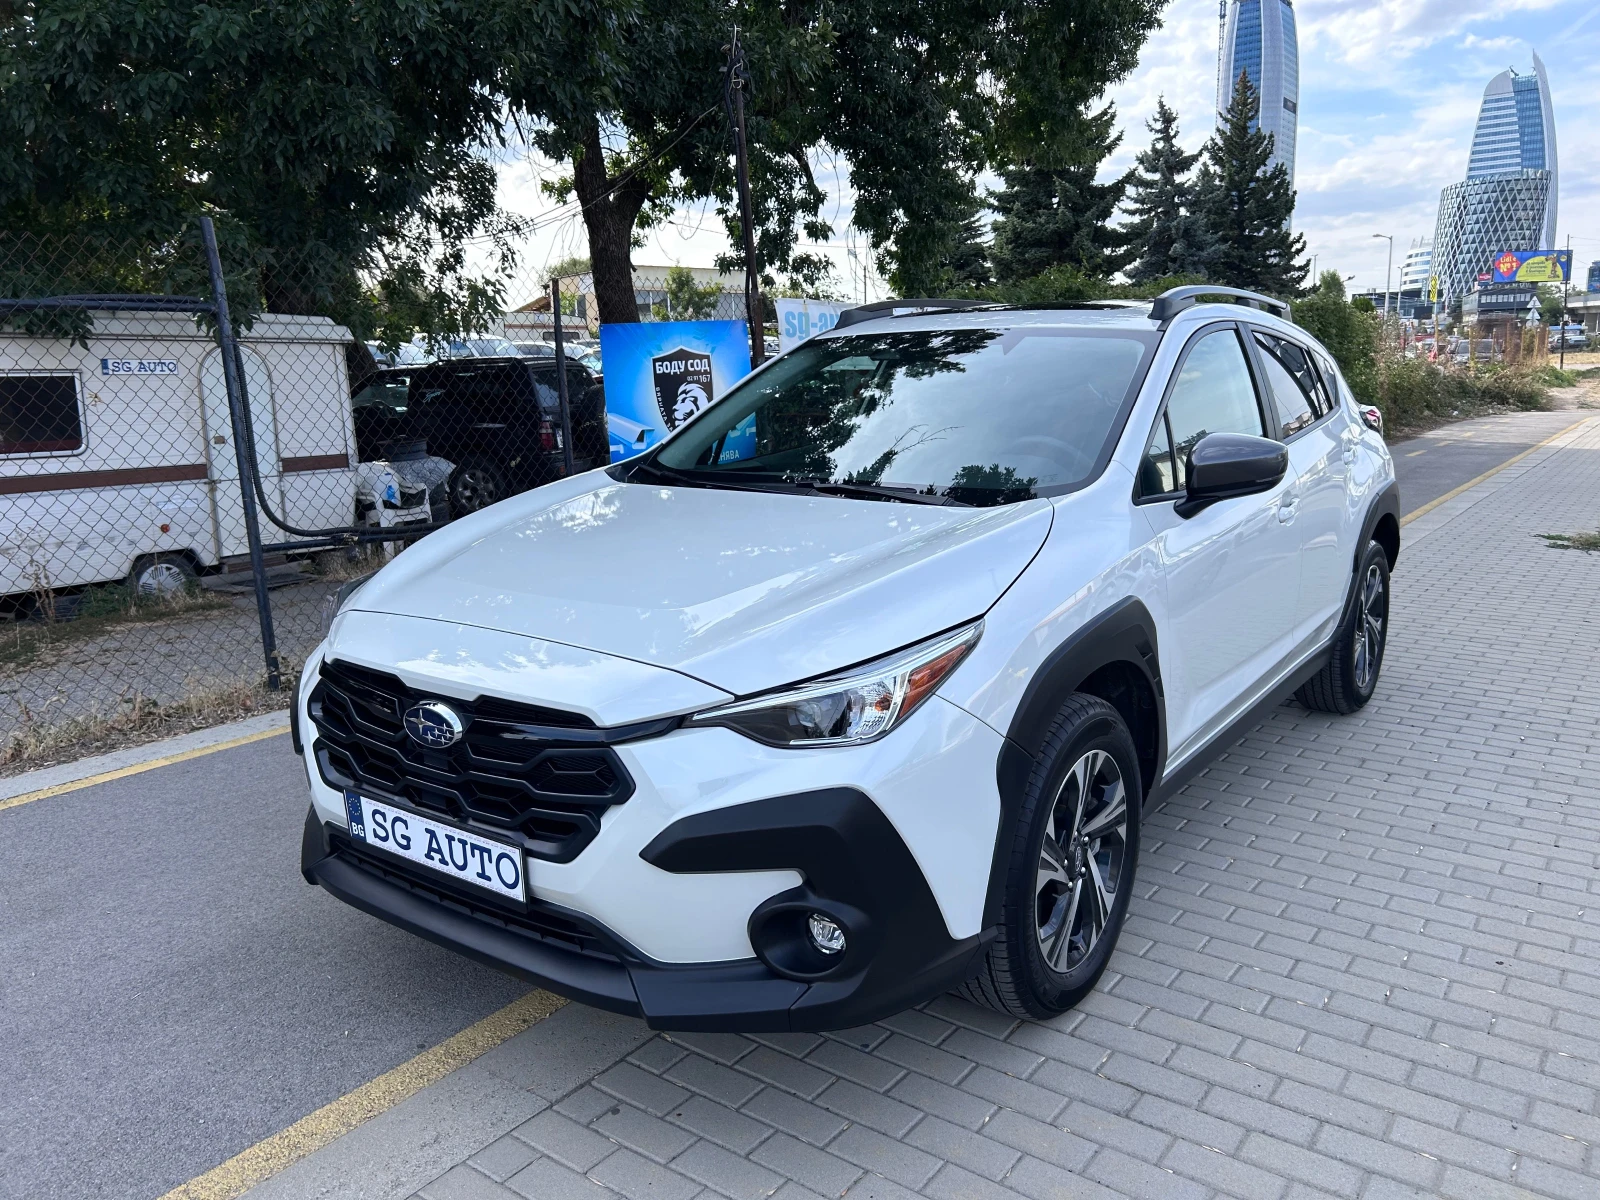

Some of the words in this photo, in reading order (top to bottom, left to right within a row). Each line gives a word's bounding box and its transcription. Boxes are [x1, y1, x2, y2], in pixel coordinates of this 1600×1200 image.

[111, 361, 132, 372] SG
[137, 361, 177, 373] AUTO
[655, 360, 686, 375] БОДУ
[687, 359, 710, 373] СОД
[699, 374, 711, 383] 167
[718, 450, 740, 461] НЯВА
[352, 821, 365, 837] BG
[371, 808, 412, 851] SG
[424, 827, 520, 890] AUTO
